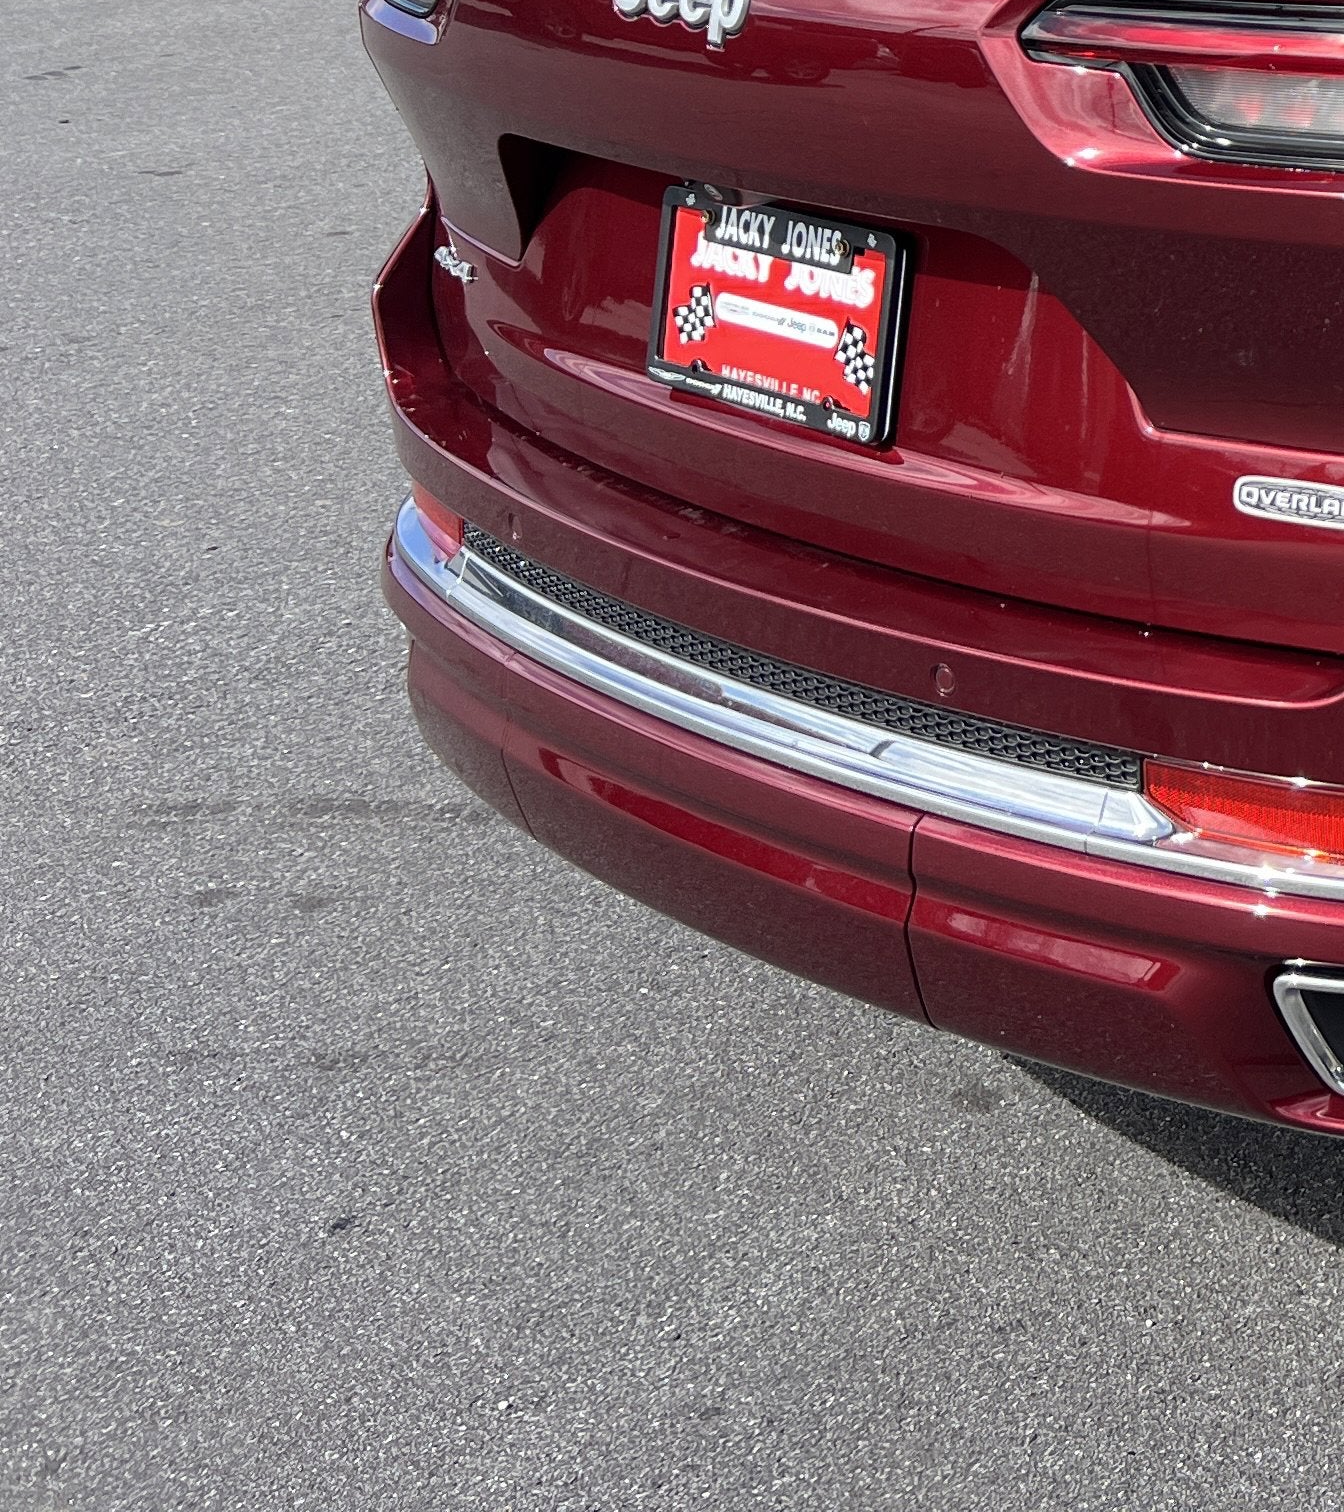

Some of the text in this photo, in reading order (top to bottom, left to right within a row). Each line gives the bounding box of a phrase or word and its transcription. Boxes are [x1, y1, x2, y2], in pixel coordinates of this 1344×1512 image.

[715, 205, 843, 266] JACKY JONES
[827, 412, 857, 437] Jeep
